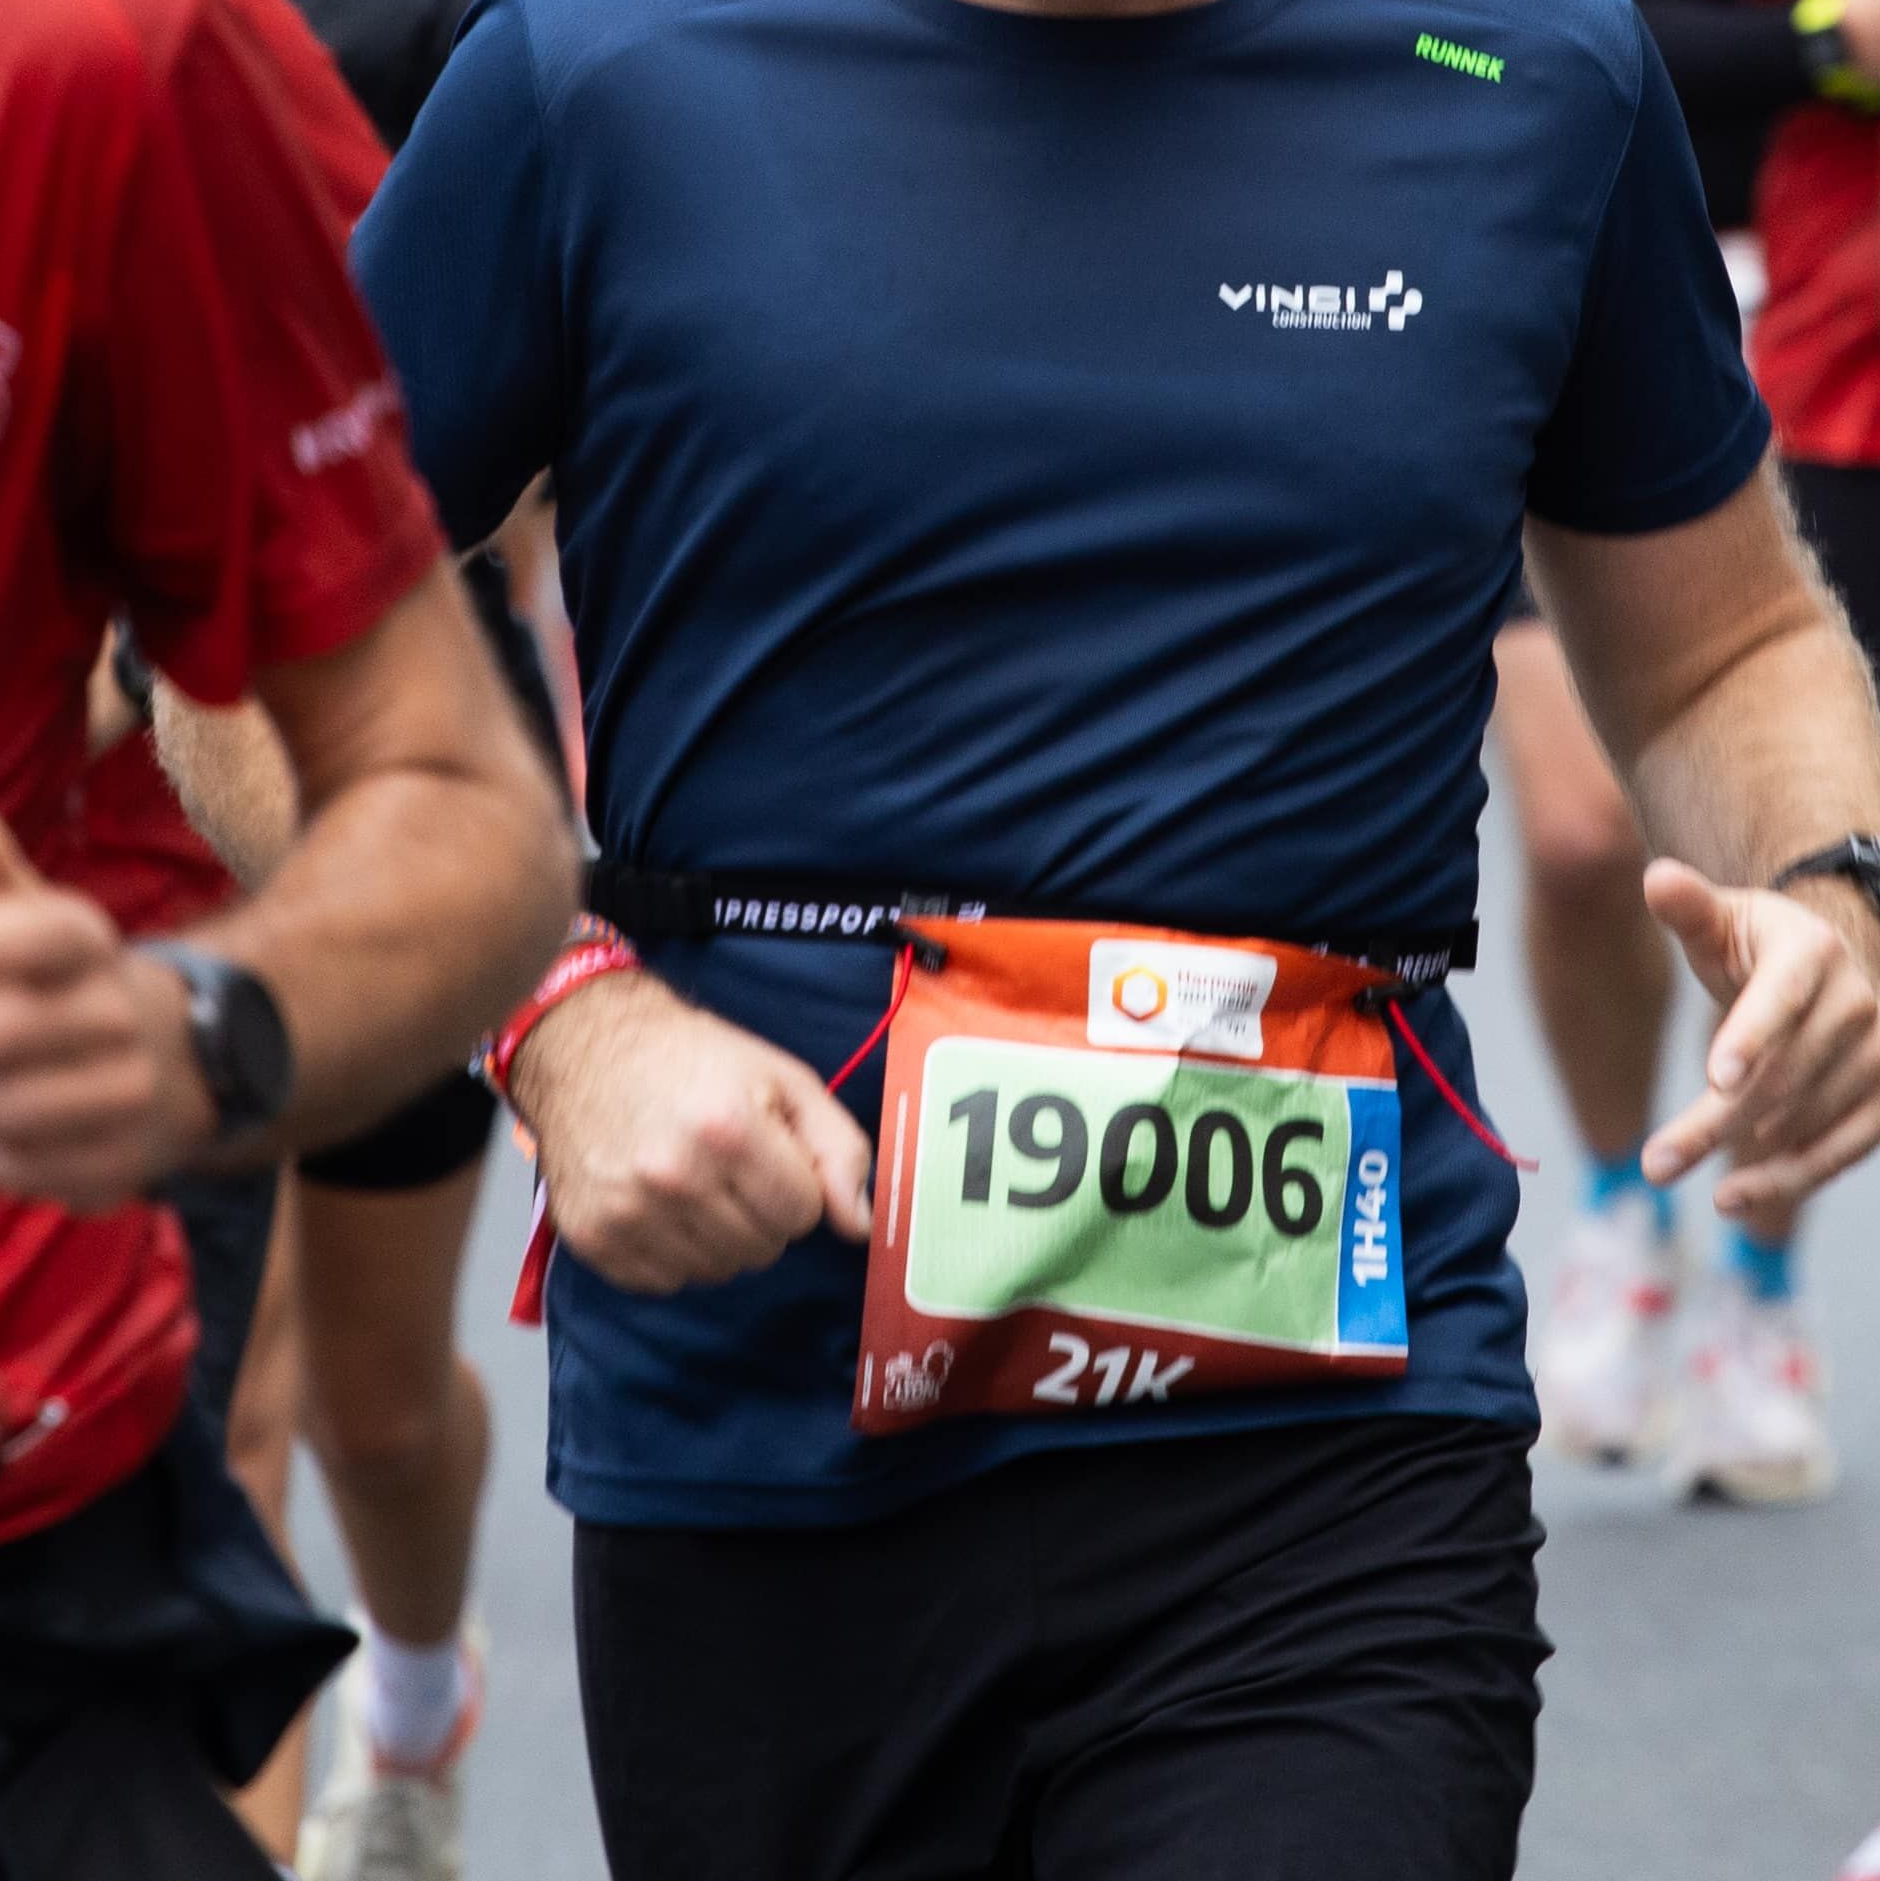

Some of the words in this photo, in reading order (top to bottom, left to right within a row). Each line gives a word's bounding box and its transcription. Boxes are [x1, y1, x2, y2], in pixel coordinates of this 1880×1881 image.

[1415, 32, 1506, 84] RUNNER
[1272, 311, 1372, 332] CONSTRUCTION
[947, 1086, 1325, 1238] 19006
[1350, 1148, 1389, 1288] 1H40
[1032, 1330, 1195, 1407] 21K
